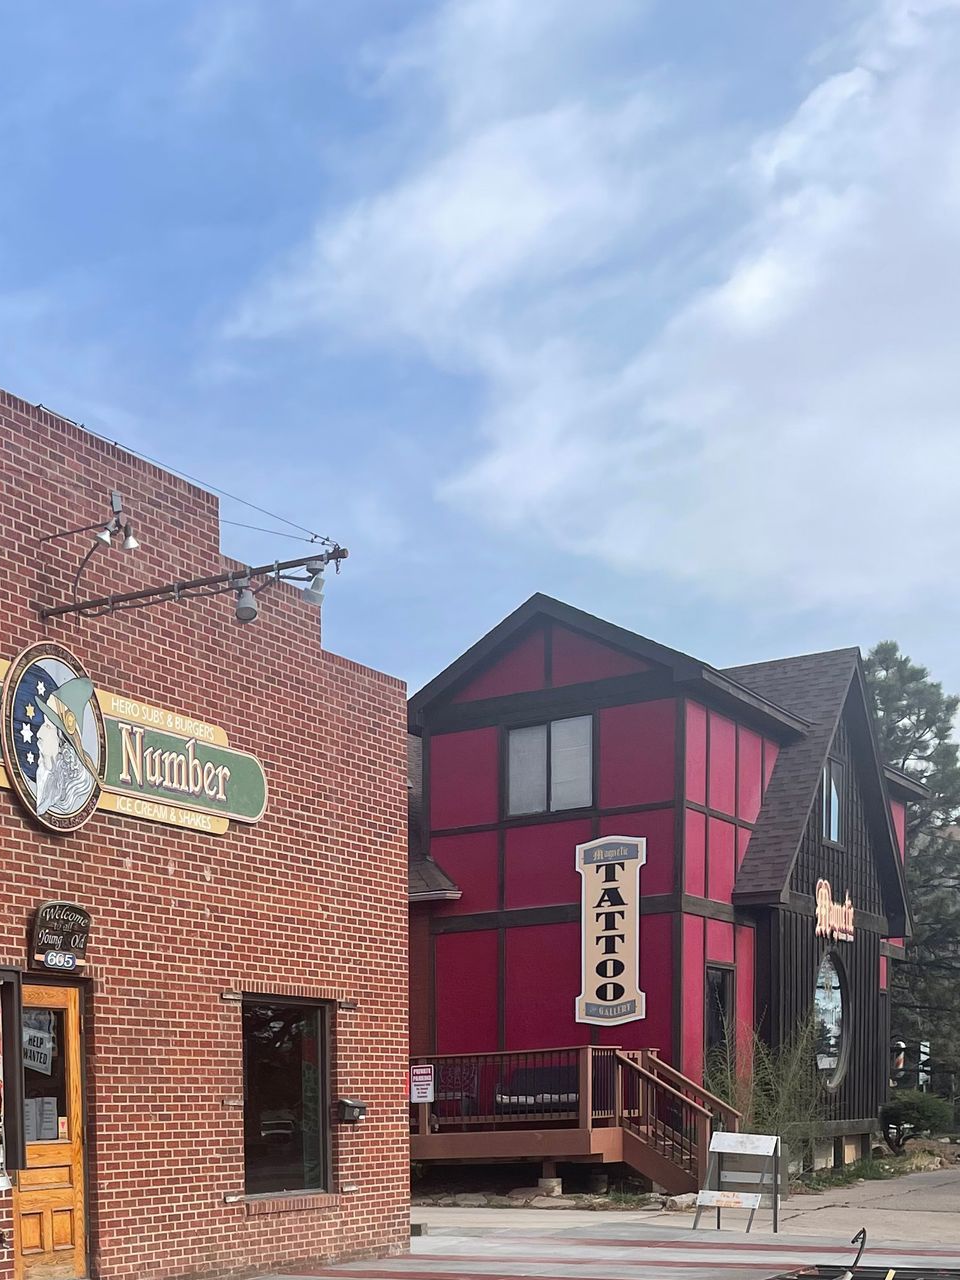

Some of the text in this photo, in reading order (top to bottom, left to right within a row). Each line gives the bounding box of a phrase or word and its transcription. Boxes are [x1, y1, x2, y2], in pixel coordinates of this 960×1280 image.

[111, 697, 215, 740] HERO SUBS & BURGERS
[118, 722, 231, 802] Number
[115, 796, 212, 830] ICE CREAM & SHAKES
[42, 906, 89, 927] Welcome
[38, 929, 87, 950] Young Old
[592, 861, 628, 1002] TATTOO
[598, 1003, 633, 1016] GALLERY
[27, 1034, 44, 1049] HELP
[22, 1049, 49, 1065] WANTED
